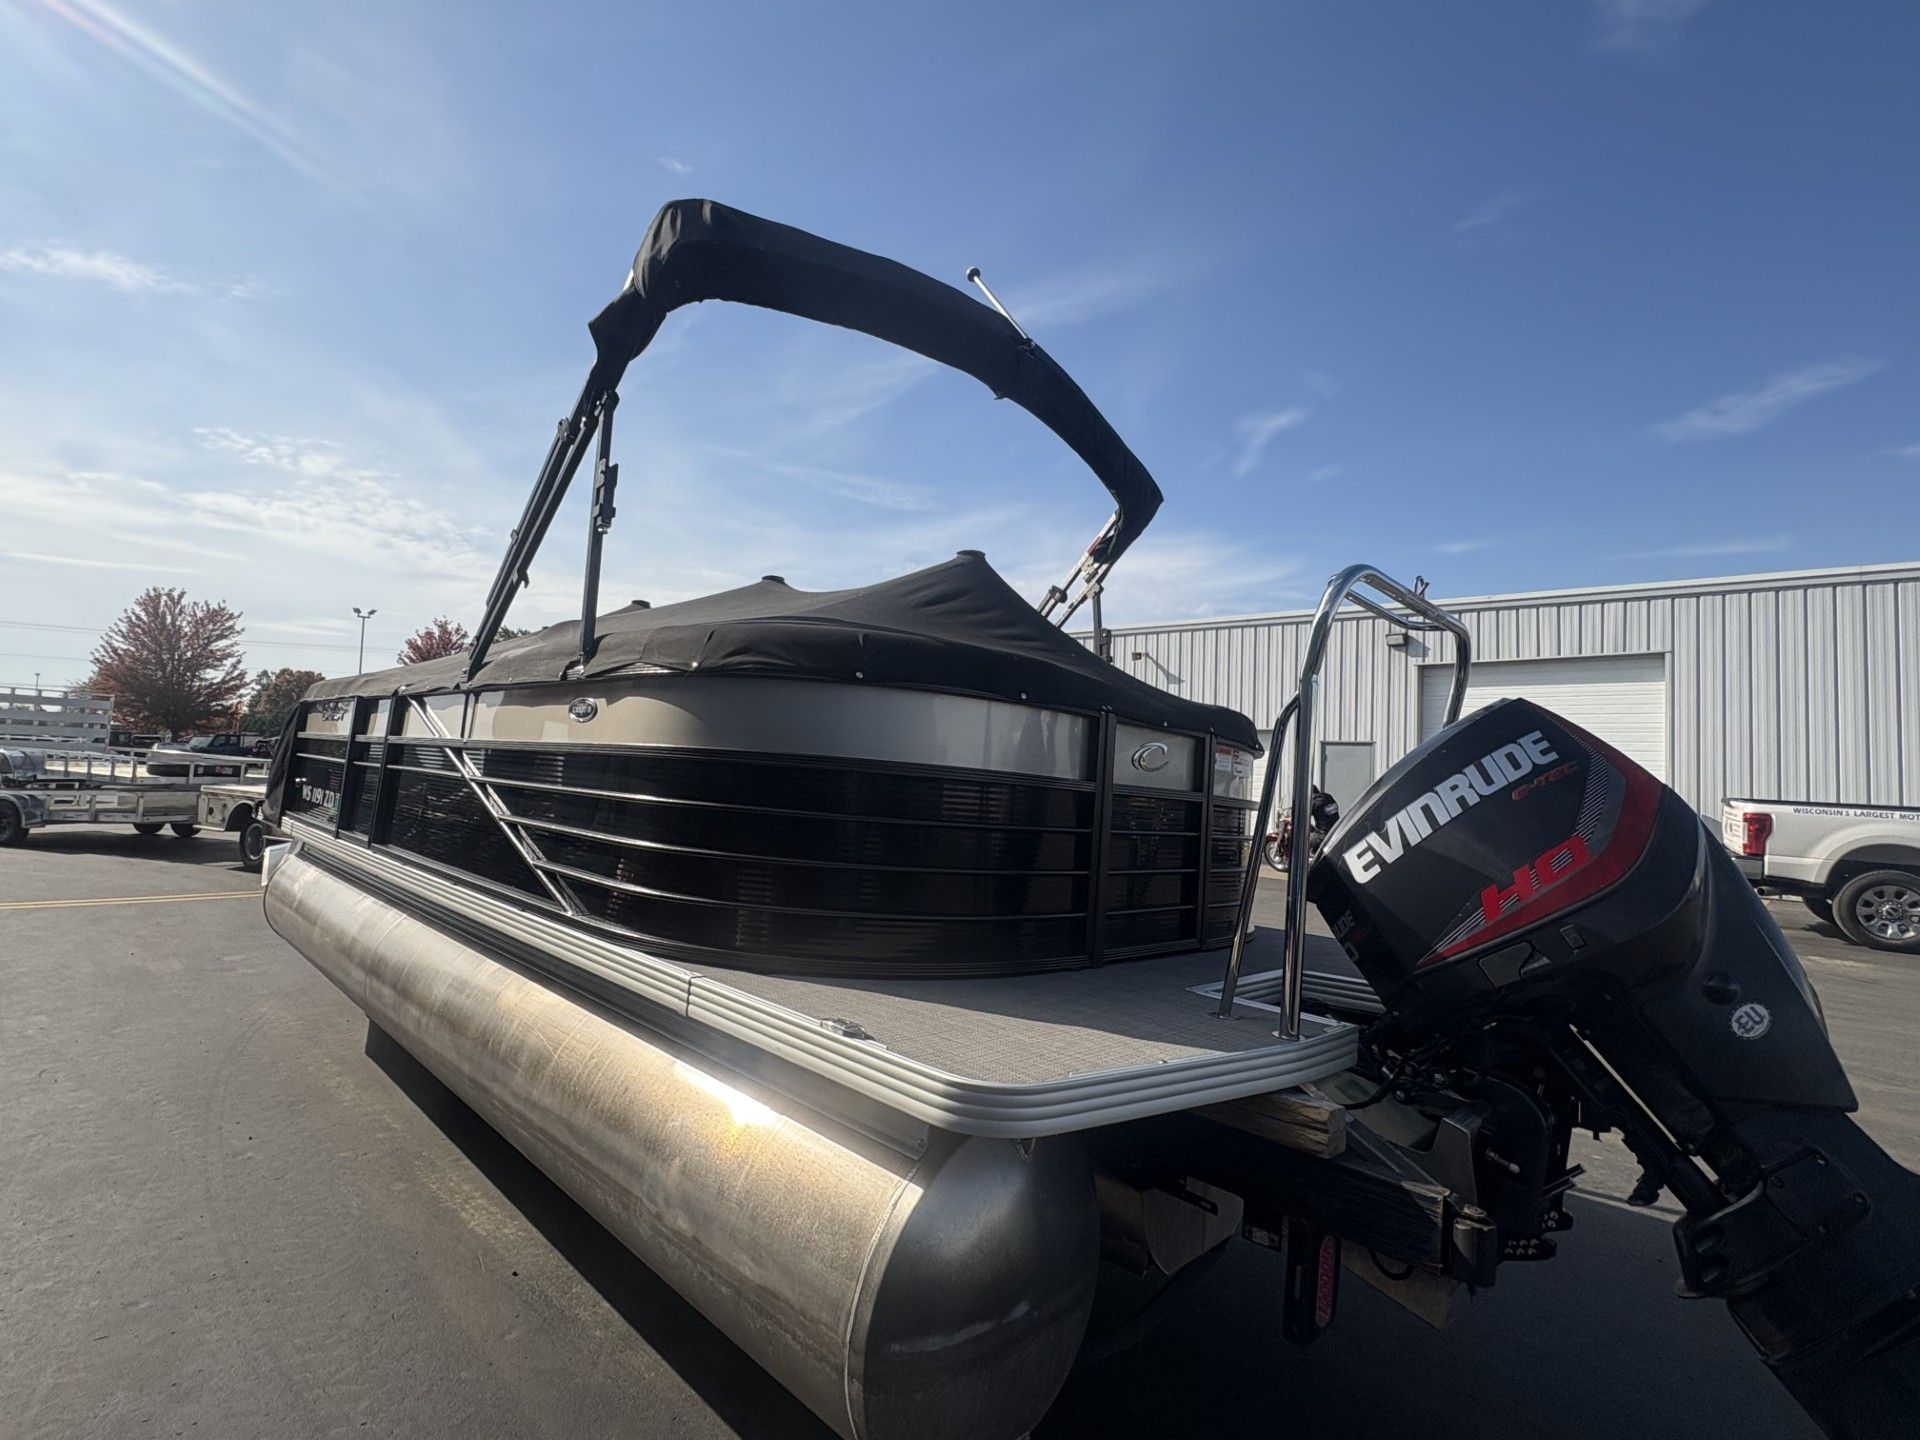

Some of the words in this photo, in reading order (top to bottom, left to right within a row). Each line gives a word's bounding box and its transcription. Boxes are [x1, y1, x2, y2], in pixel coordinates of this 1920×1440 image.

[1342, 730, 1559, 884] EVINRUDE
[1793, 807, 1850, 816] WISCONSINS
[1854, 810, 1895, 819] LARGEST
[1481, 836, 1590, 922] HO
